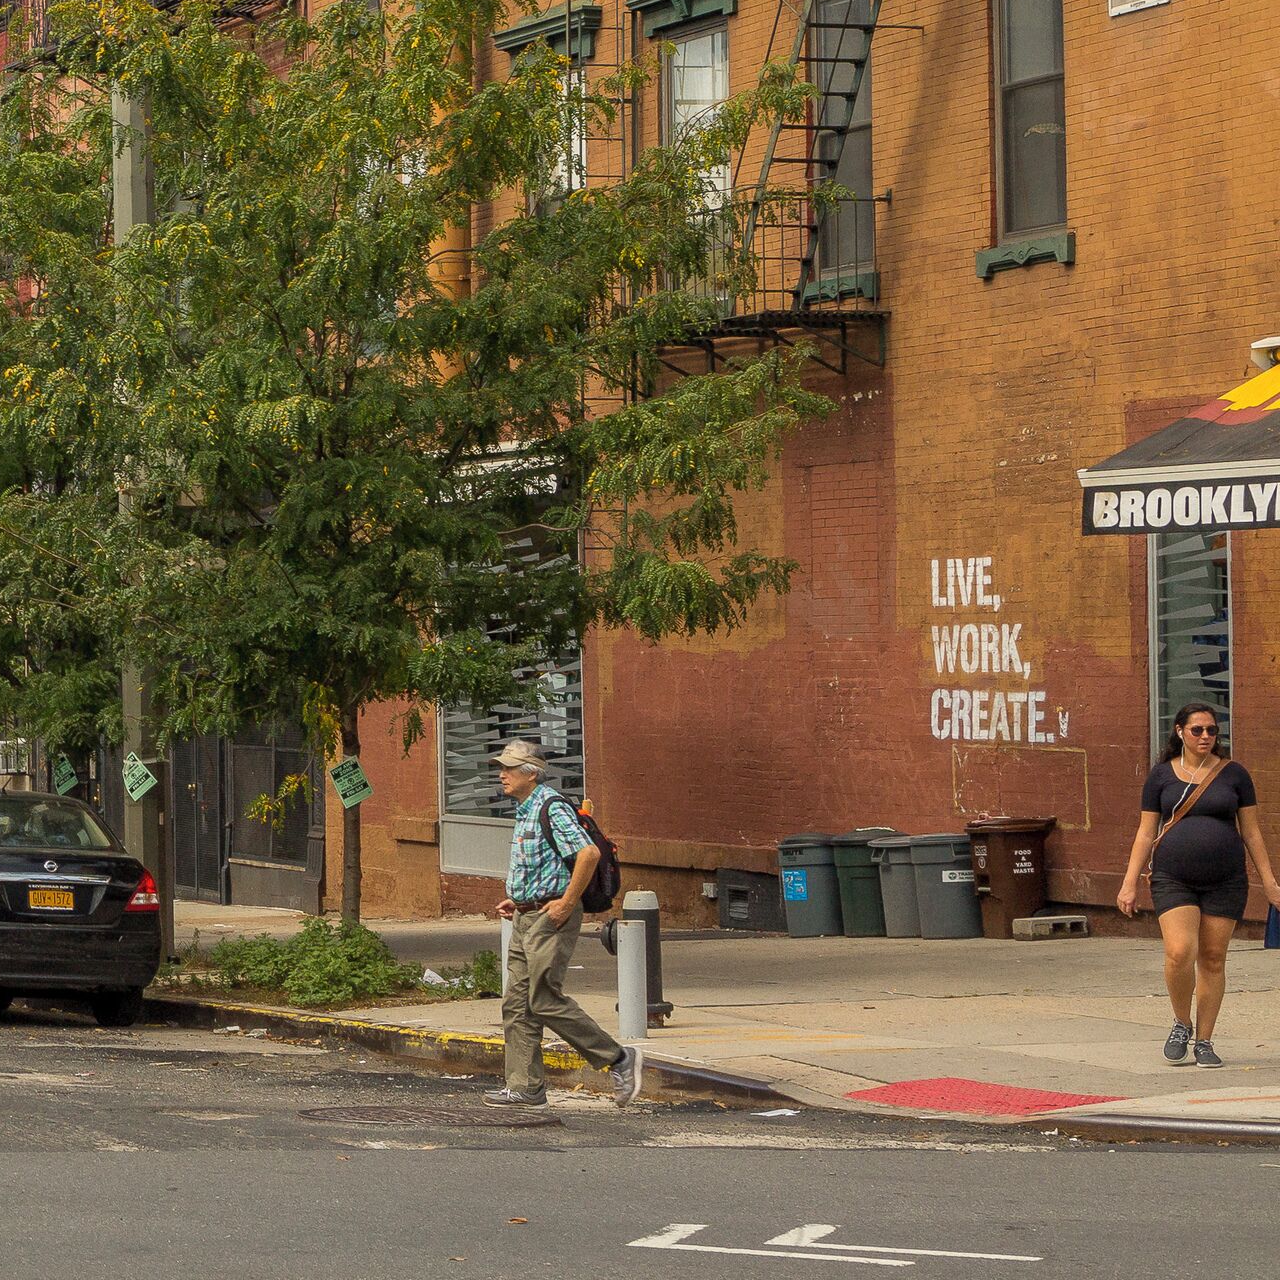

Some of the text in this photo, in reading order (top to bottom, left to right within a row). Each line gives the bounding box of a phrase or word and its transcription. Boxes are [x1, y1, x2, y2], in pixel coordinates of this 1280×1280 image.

[1092, 482, 1280, 528] BROOKLY
[931, 556, 1001, 612] LIVE,
[931, 623, 1031, 680] WORK,
[930, 688, 1055, 743] CREATE.
